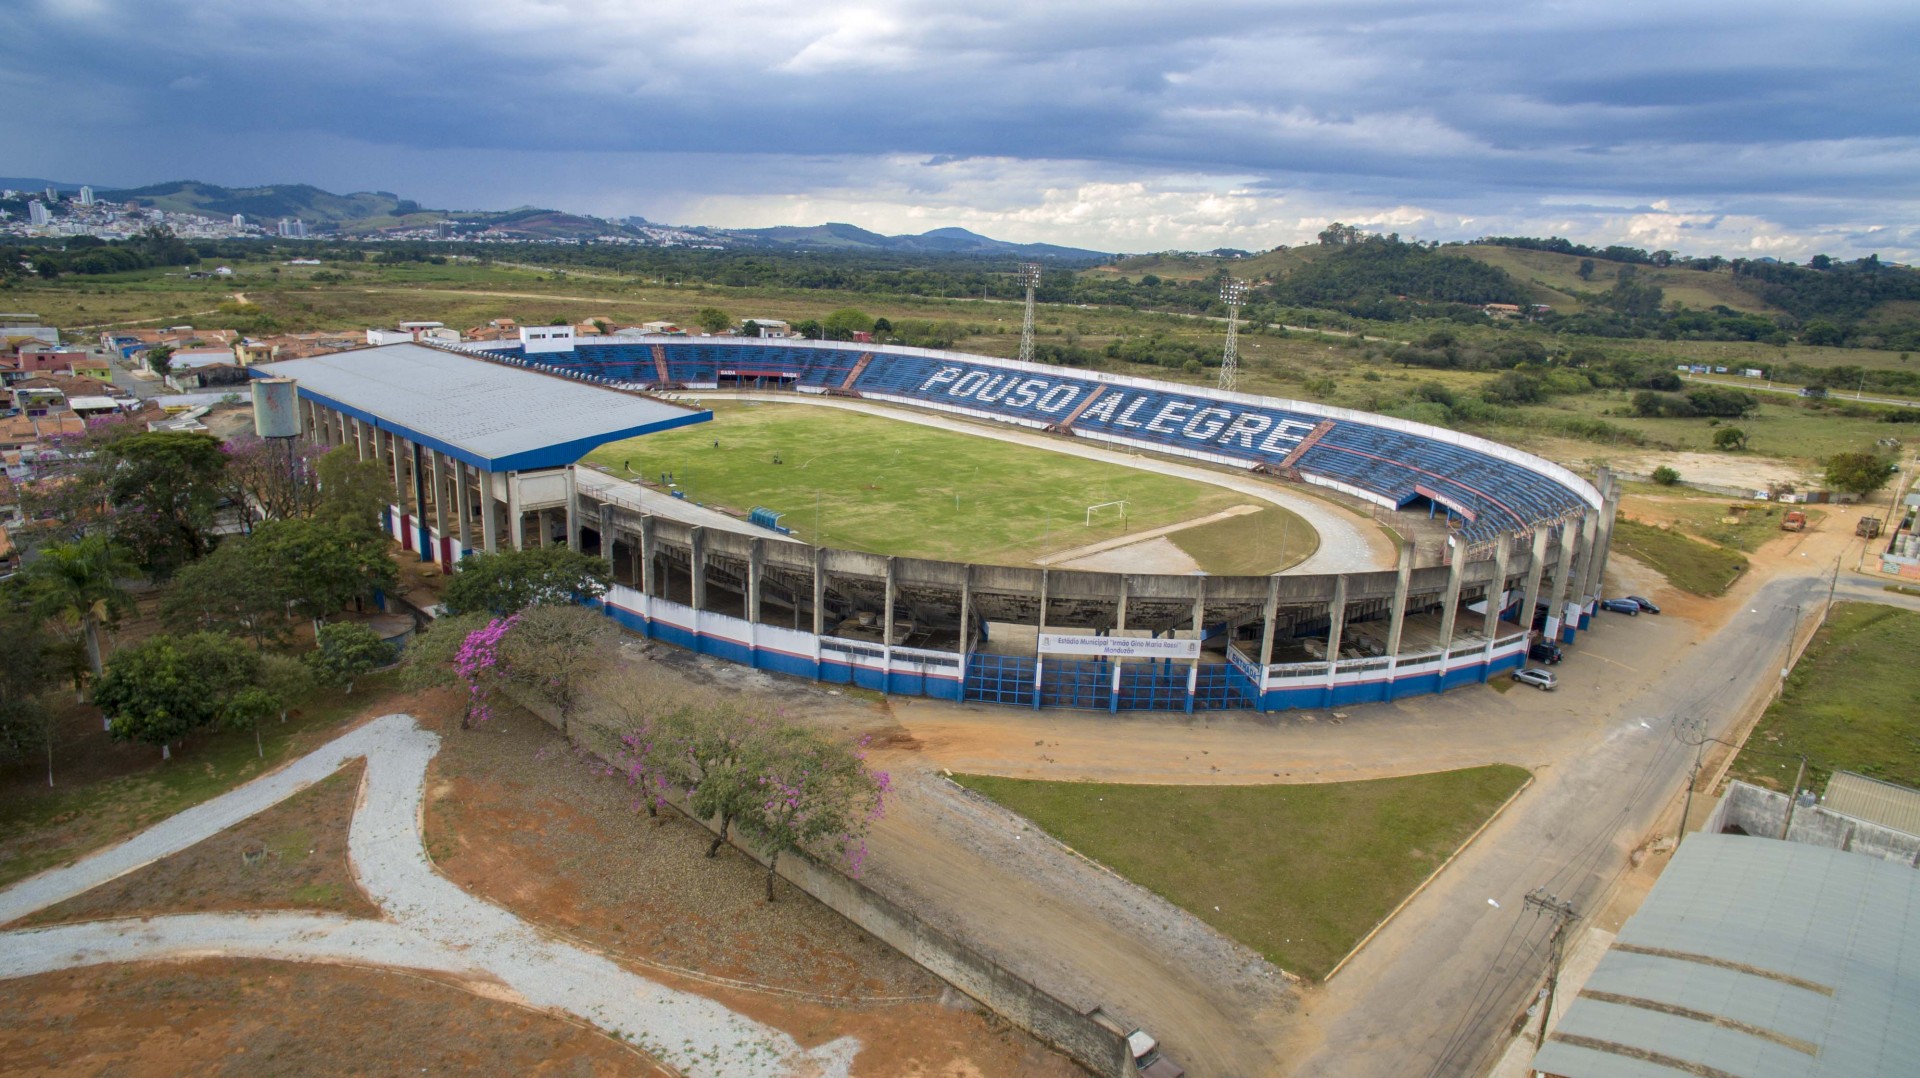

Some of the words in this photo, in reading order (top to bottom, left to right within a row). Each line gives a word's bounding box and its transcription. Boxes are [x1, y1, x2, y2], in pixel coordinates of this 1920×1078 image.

[919, 366, 1080, 413] POUSO
[1080, 392, 1315, 453] ALEGRE
[1057, 637, 1079, 645] Estádio
[1080, 639, 1109, 647] Municipal
[1130, 640, 1144, 648] Gino
